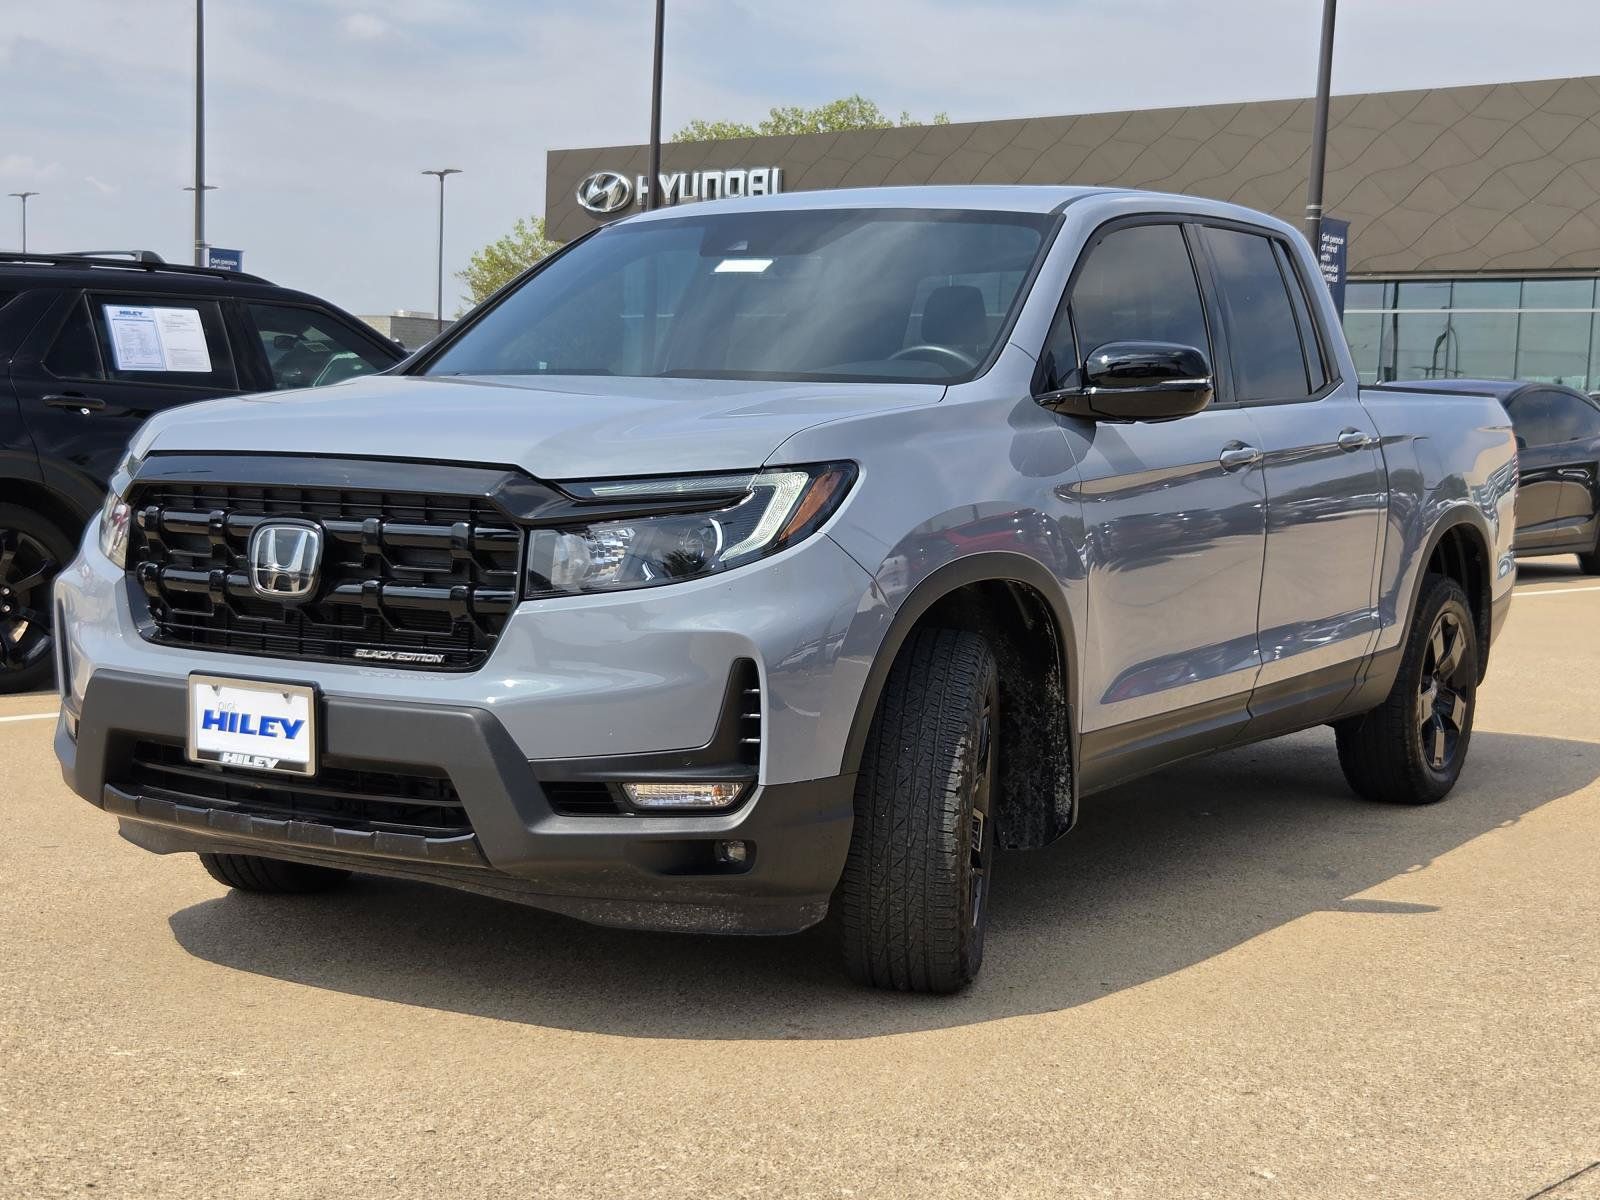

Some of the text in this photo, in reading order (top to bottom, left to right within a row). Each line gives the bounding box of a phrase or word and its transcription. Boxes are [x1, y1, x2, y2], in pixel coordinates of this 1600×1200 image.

[637, 167, 783, 205] HYUNDAI
[1321, 232, 1344, 245] Get peace
[353, 648, 446, 663] BLACK EDITION
[202, 708, 306, 740] HILEY
[222, 752, 280, 769] HILEY
